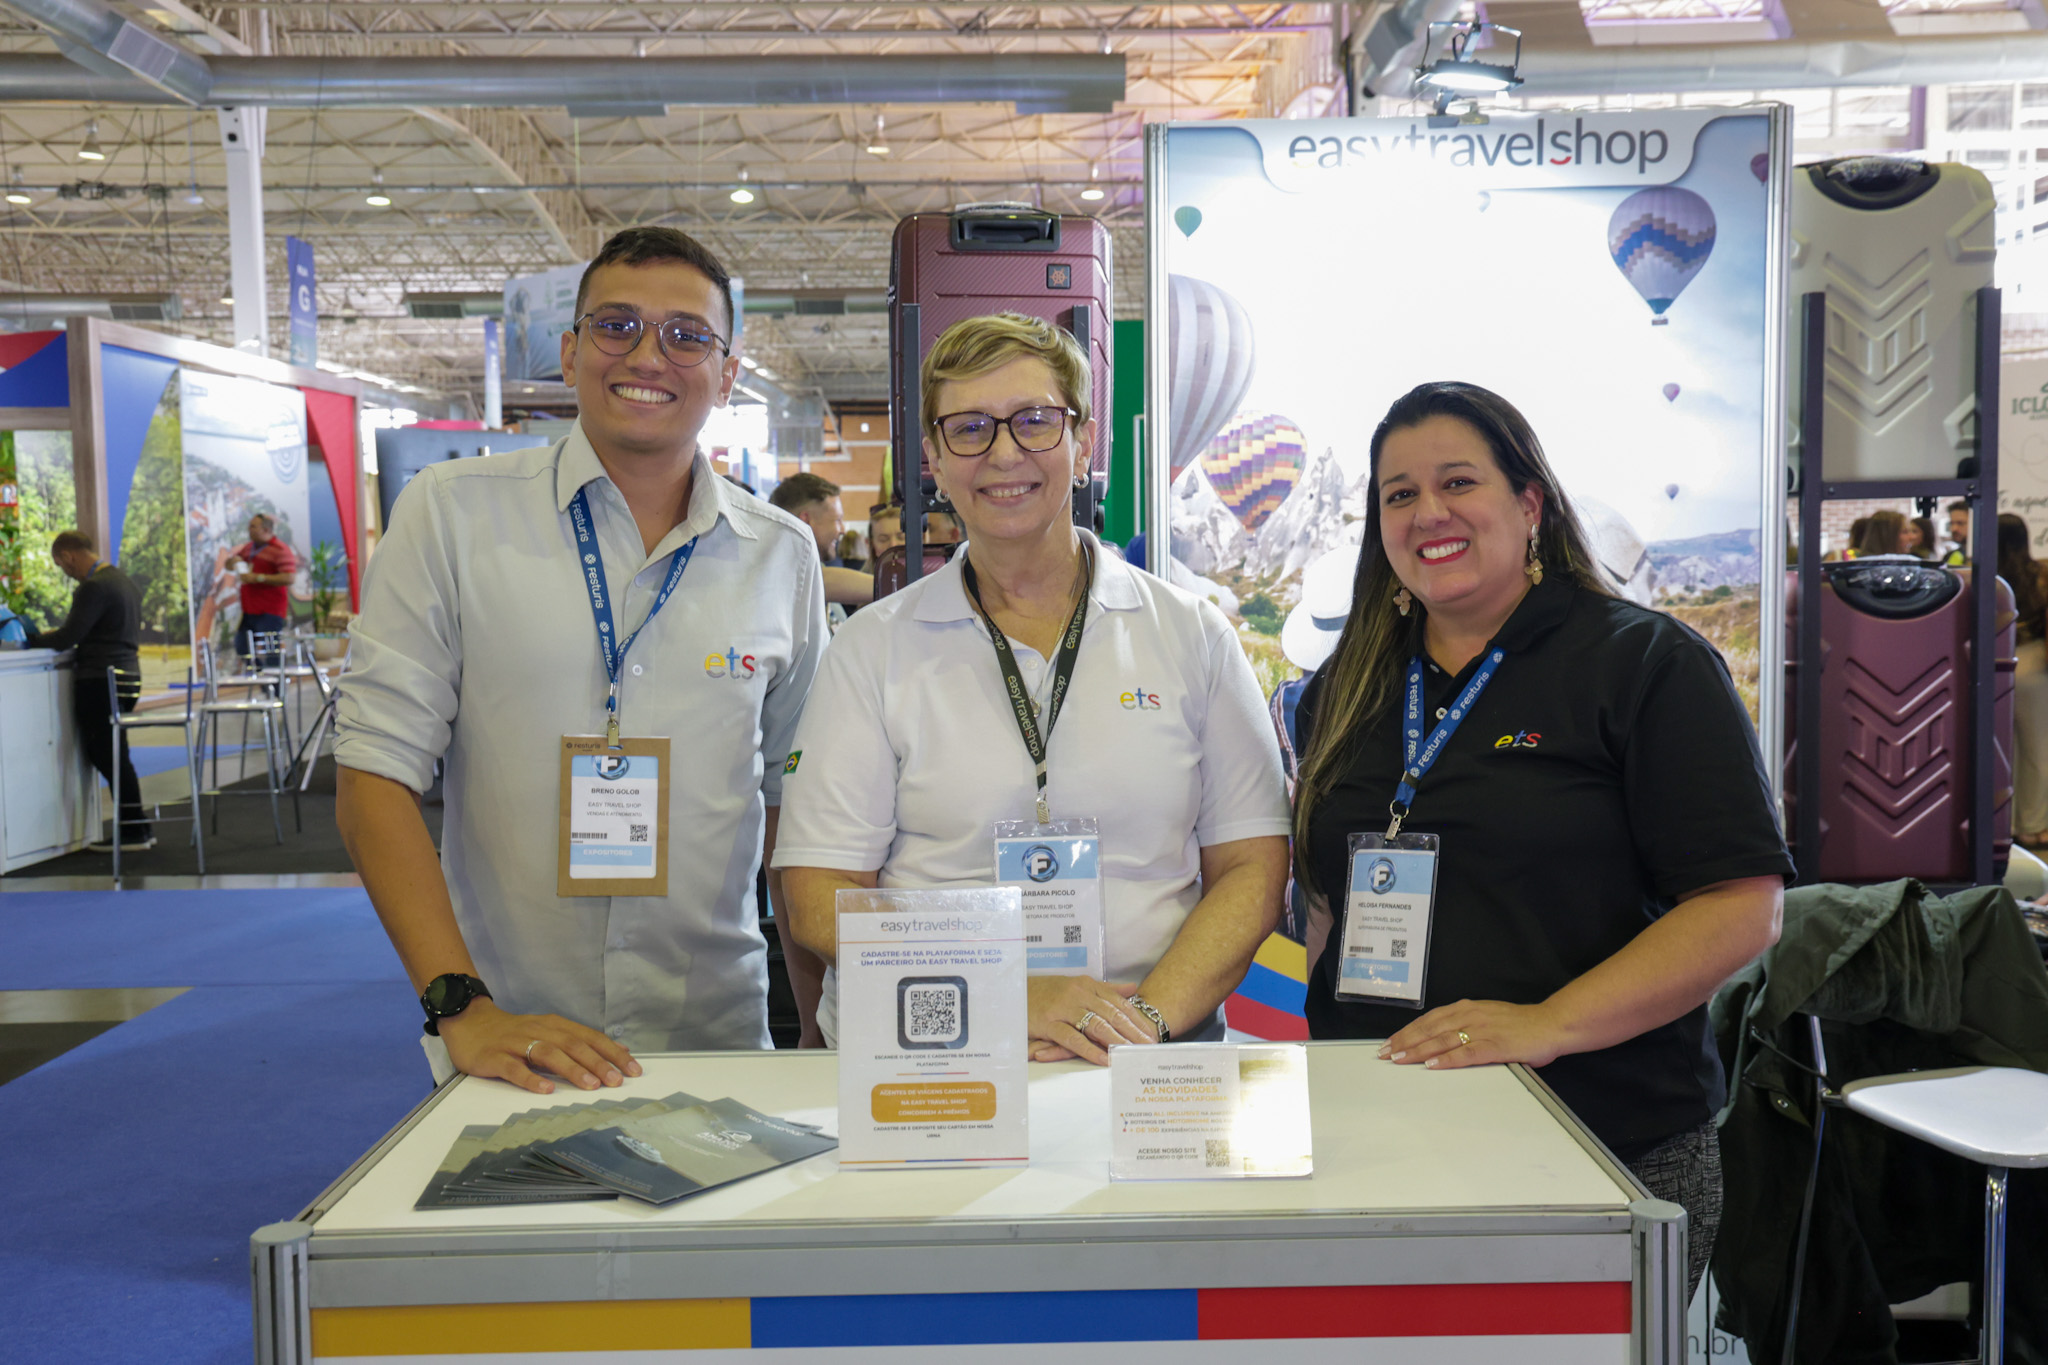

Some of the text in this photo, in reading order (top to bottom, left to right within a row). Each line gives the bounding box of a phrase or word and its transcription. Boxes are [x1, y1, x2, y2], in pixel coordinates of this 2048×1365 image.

[572, 503, 589, 542] Festuris
[588, 566, 604, 609] Festuris
[666, 556, 686, 594] Festuris
[1066, 583, 1088, 650] easytravel
[602, 635, 614, 674] Festur
[704, 646, 756, 680] ets
[1120, 687, 1162, 710] ets
[1408, 684, 1420, 720] Festuris
[1460, 672, 1490, 710] Festuris
[1008, 674, 1040, 757] easytravelshop
[1408, 740, 1416, 764] Fest
[1418, 729, 1448, 767] Festuris
[1494, 730, 1542, 748] ets
[881, 918, 982, 933] easytravelshop
[1158, 1085, 1218, 1094] NOVIDADES
